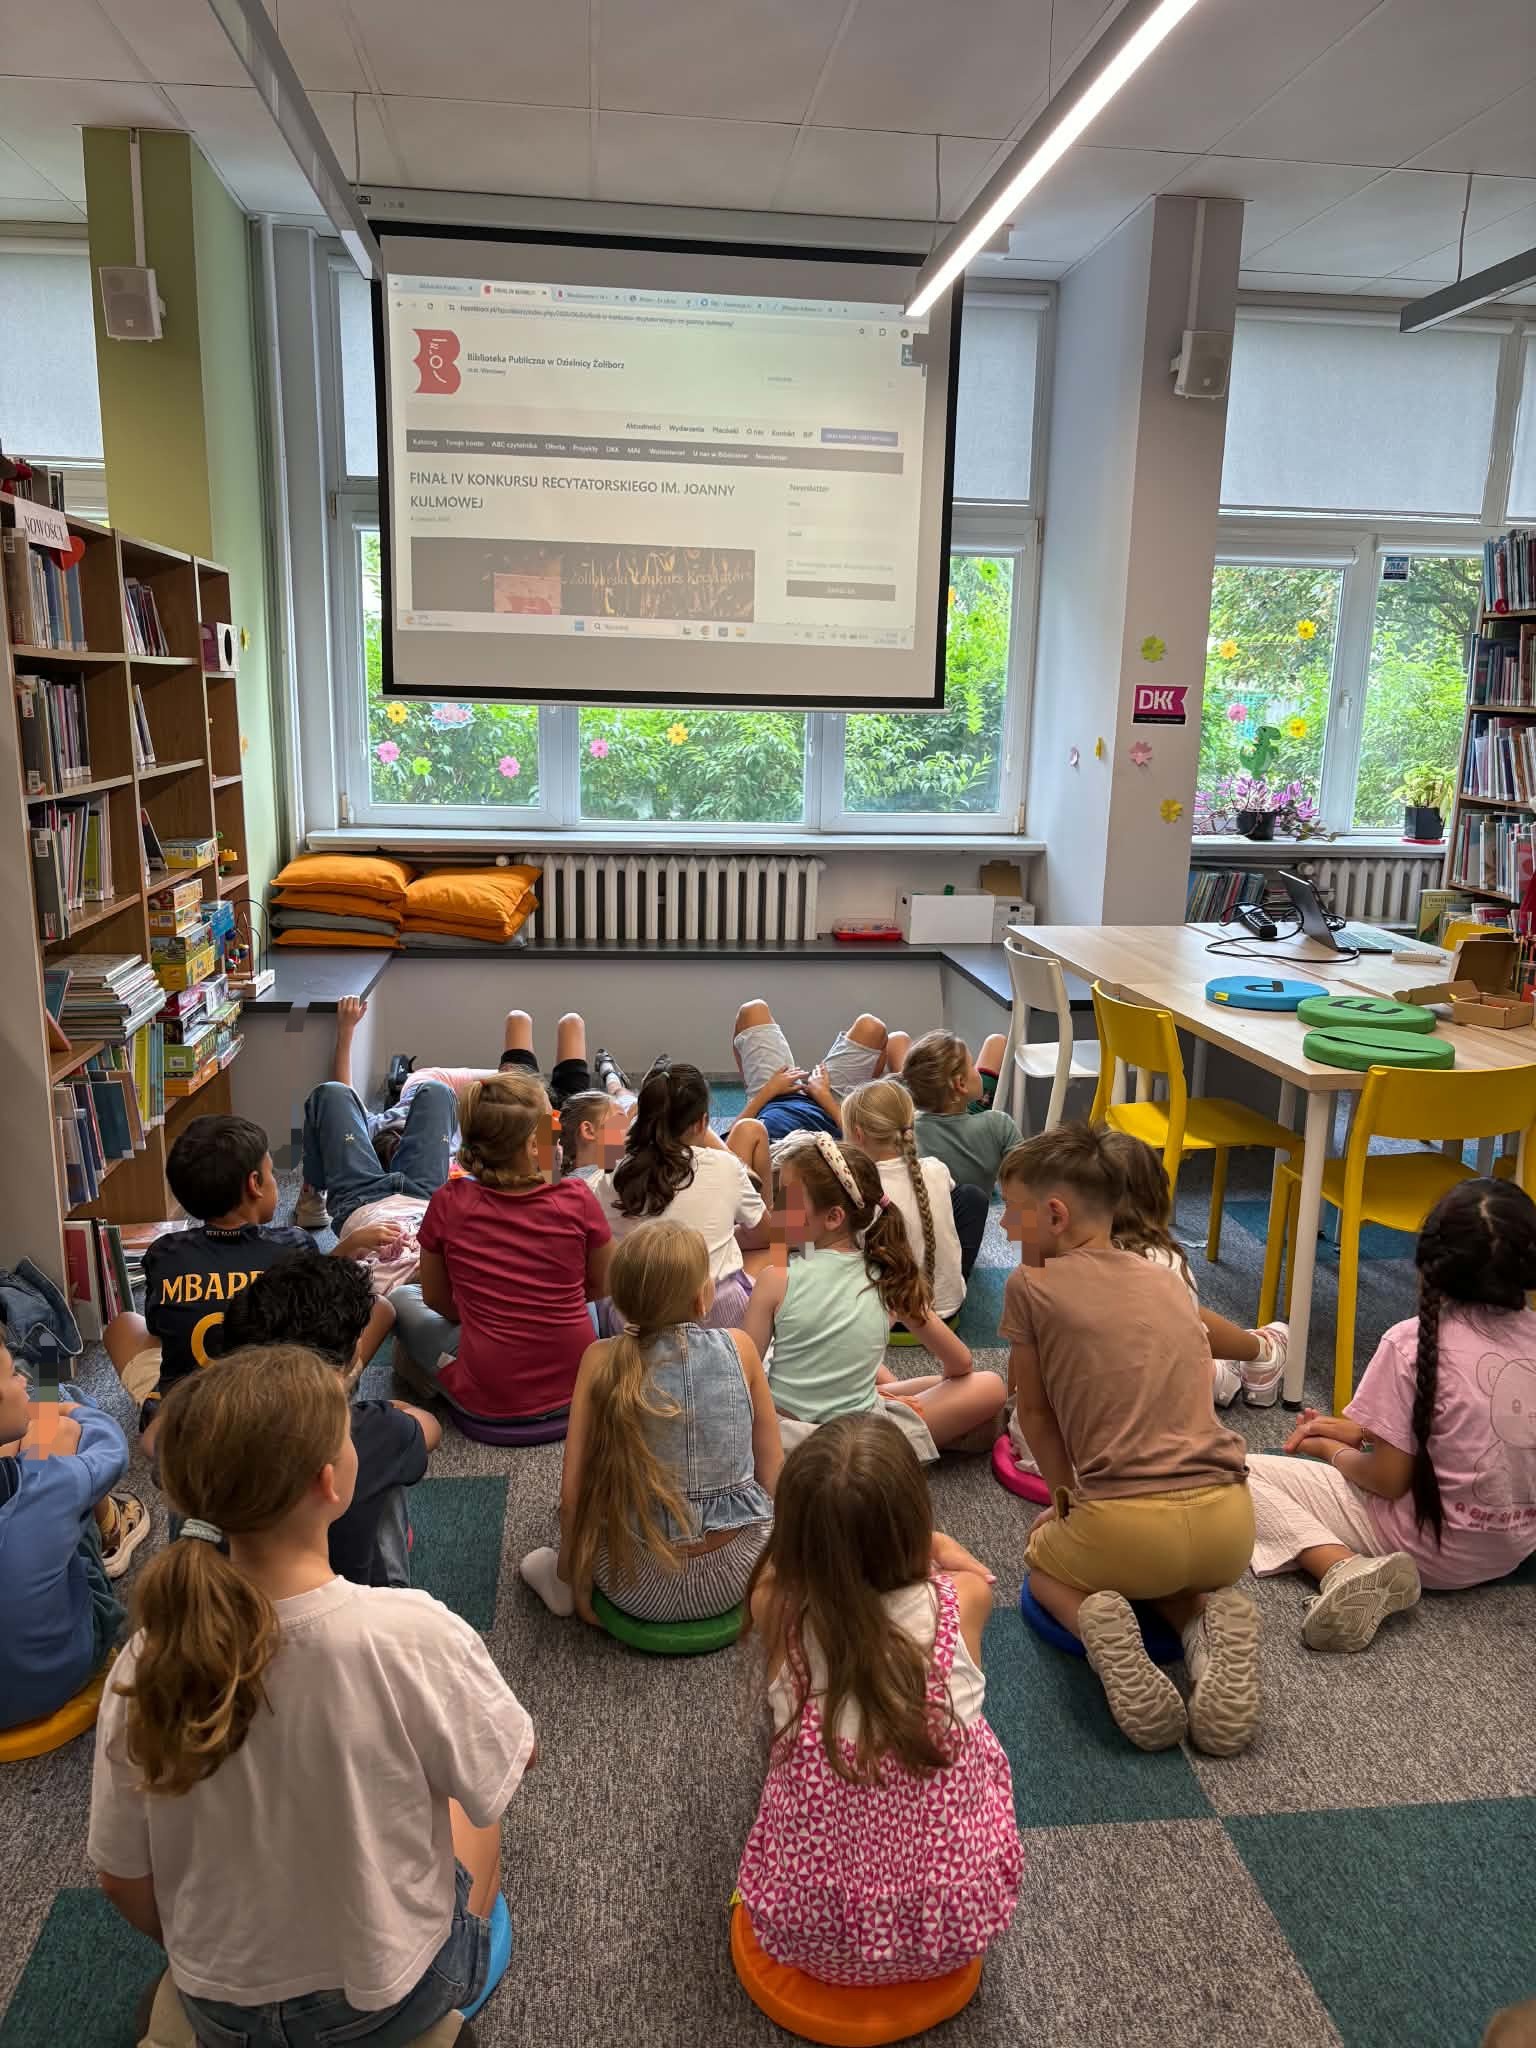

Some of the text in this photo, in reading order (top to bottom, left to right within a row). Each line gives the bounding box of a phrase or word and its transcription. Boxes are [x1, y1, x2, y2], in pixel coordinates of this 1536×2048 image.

[467, 352, 506, 363] Biblioteka
[508, 355, 546, 365] Publiczna
[547, 358, 555, 366] w
[557, 358, 591, 369] Dzielnicy
[409, 471, 736, 497] FINAŁ IV KONKURSU RECYTATORSKIEGO IM. JOANNY
[409, 495, 484, 509] KULMOWEJ
[23, 515, 65, 544] NOWOŚCI
[1138, 689, 1175, 711] DKK
